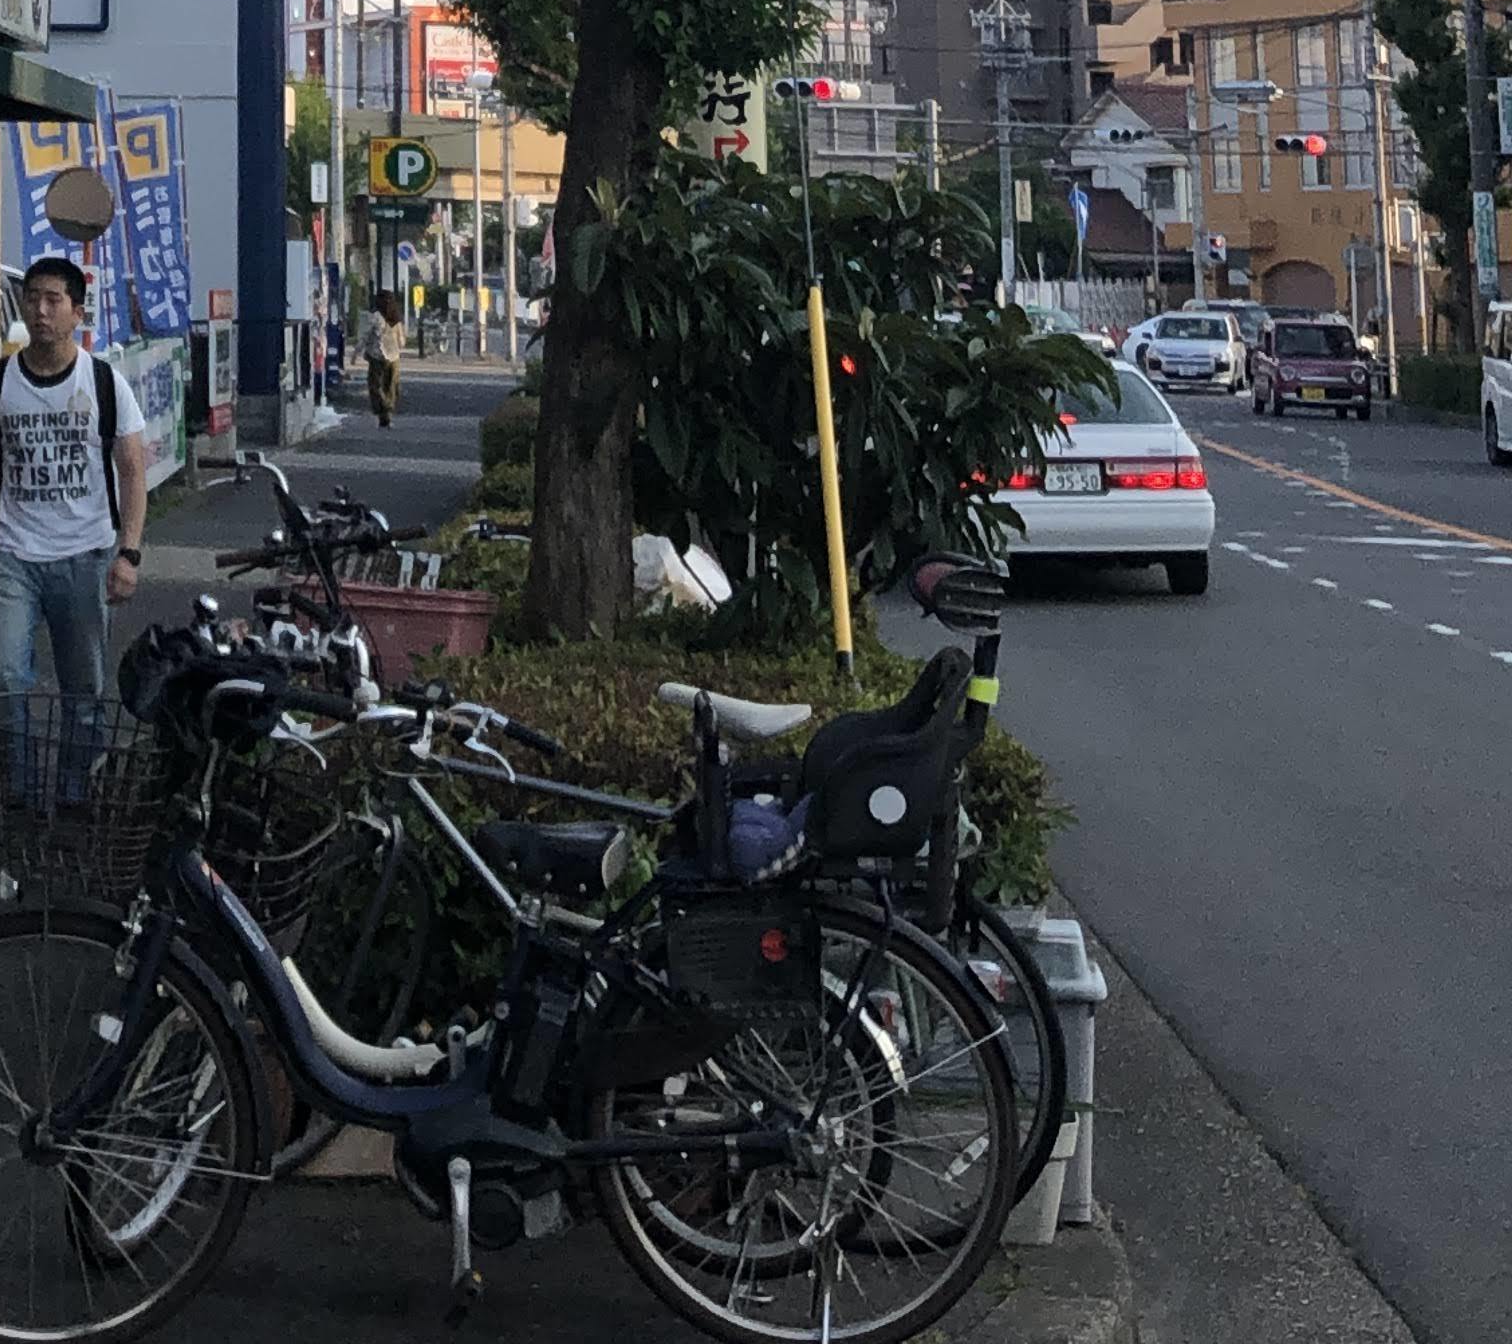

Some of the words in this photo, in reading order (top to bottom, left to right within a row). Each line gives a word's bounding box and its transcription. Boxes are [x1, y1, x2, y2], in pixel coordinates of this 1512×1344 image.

[398, 150, 425, 186] P
[30, 465, 51, 486] IS
[57, 462, 88, 485] MY
